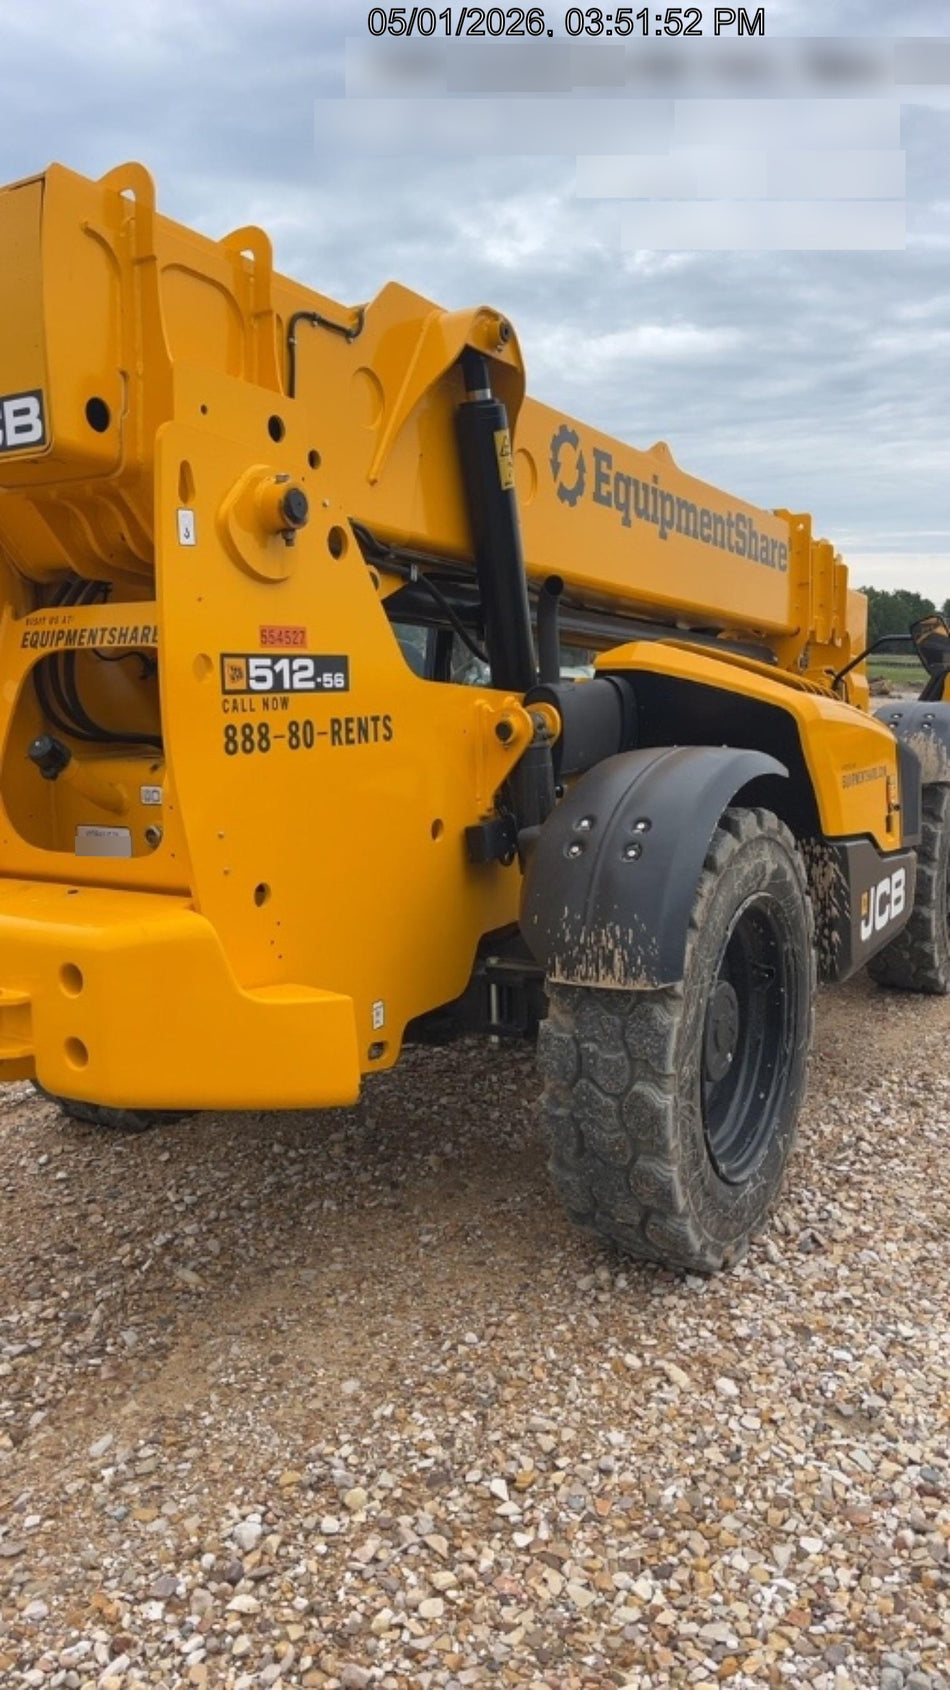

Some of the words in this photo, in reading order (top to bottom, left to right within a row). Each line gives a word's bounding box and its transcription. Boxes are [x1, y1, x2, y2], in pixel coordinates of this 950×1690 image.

[0, 396, 43, 446] B
[593, 447, 787, 572] EquipmentShare
[222, 698, 256, 714] CALL
[262, 697, 290, 711] NOW
[224, 714, 393, 756] 888-80-RENTS
[861, 867, 905, 942] JCB
